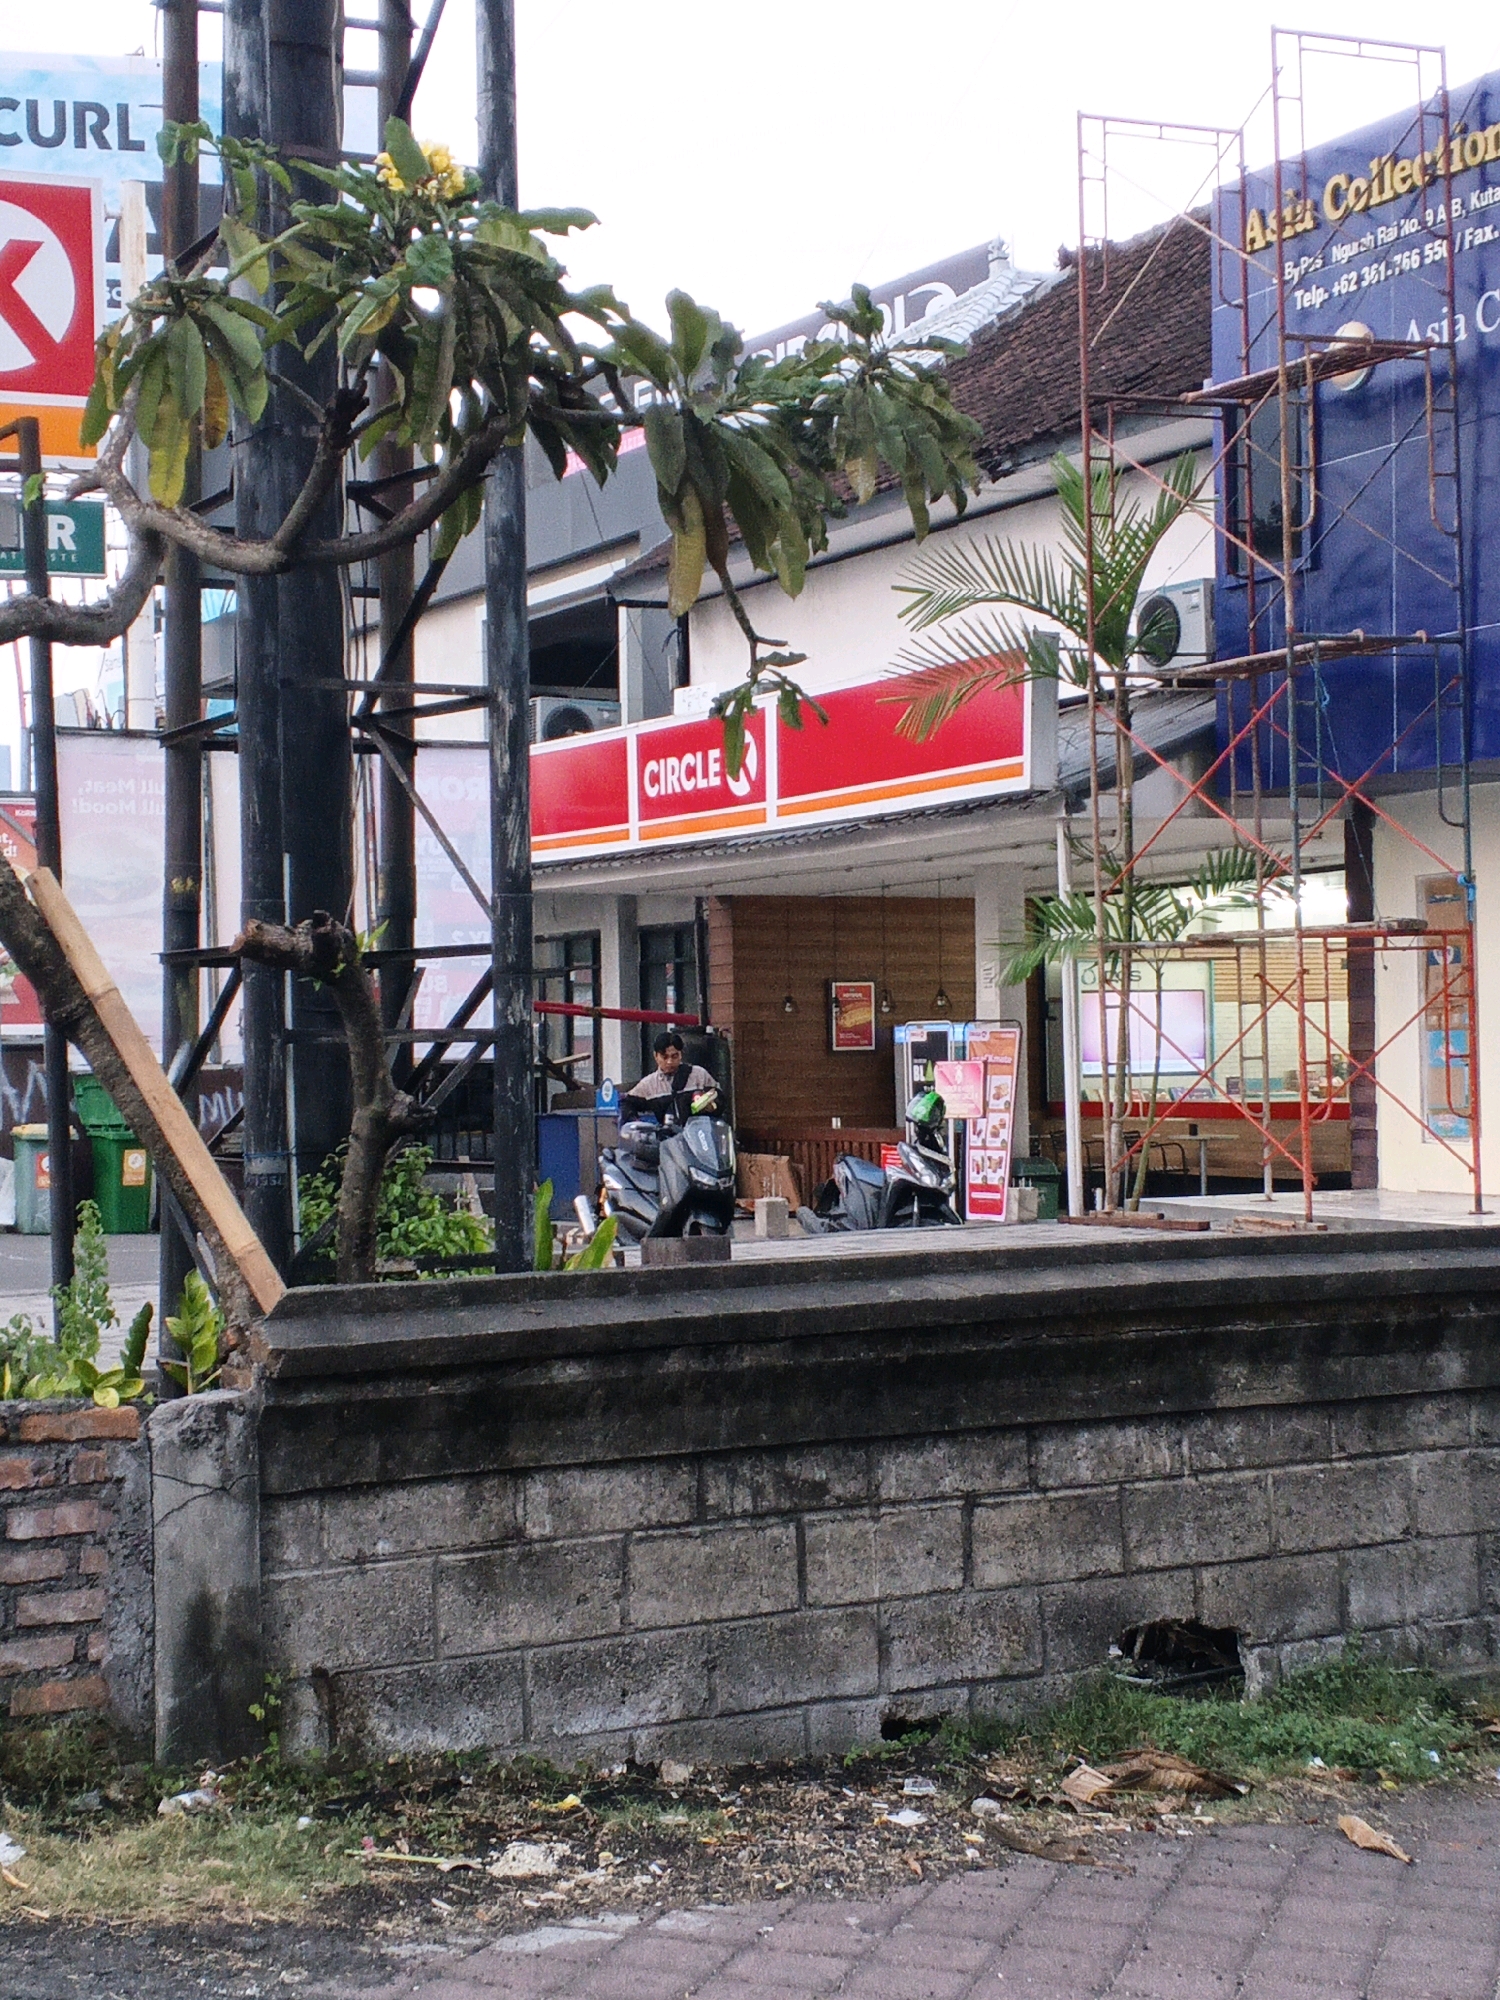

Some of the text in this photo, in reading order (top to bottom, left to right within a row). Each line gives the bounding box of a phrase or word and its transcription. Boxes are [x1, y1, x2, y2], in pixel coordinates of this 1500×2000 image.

[1246, 188, 1315, 252] Asia
[1294, 284, 1329, 310] Telp.
[1332, 271, 1358, 297] +62
[1464, 223, 1500, 250] Fax.
[643, 748, 721, 798] CIRCLE
